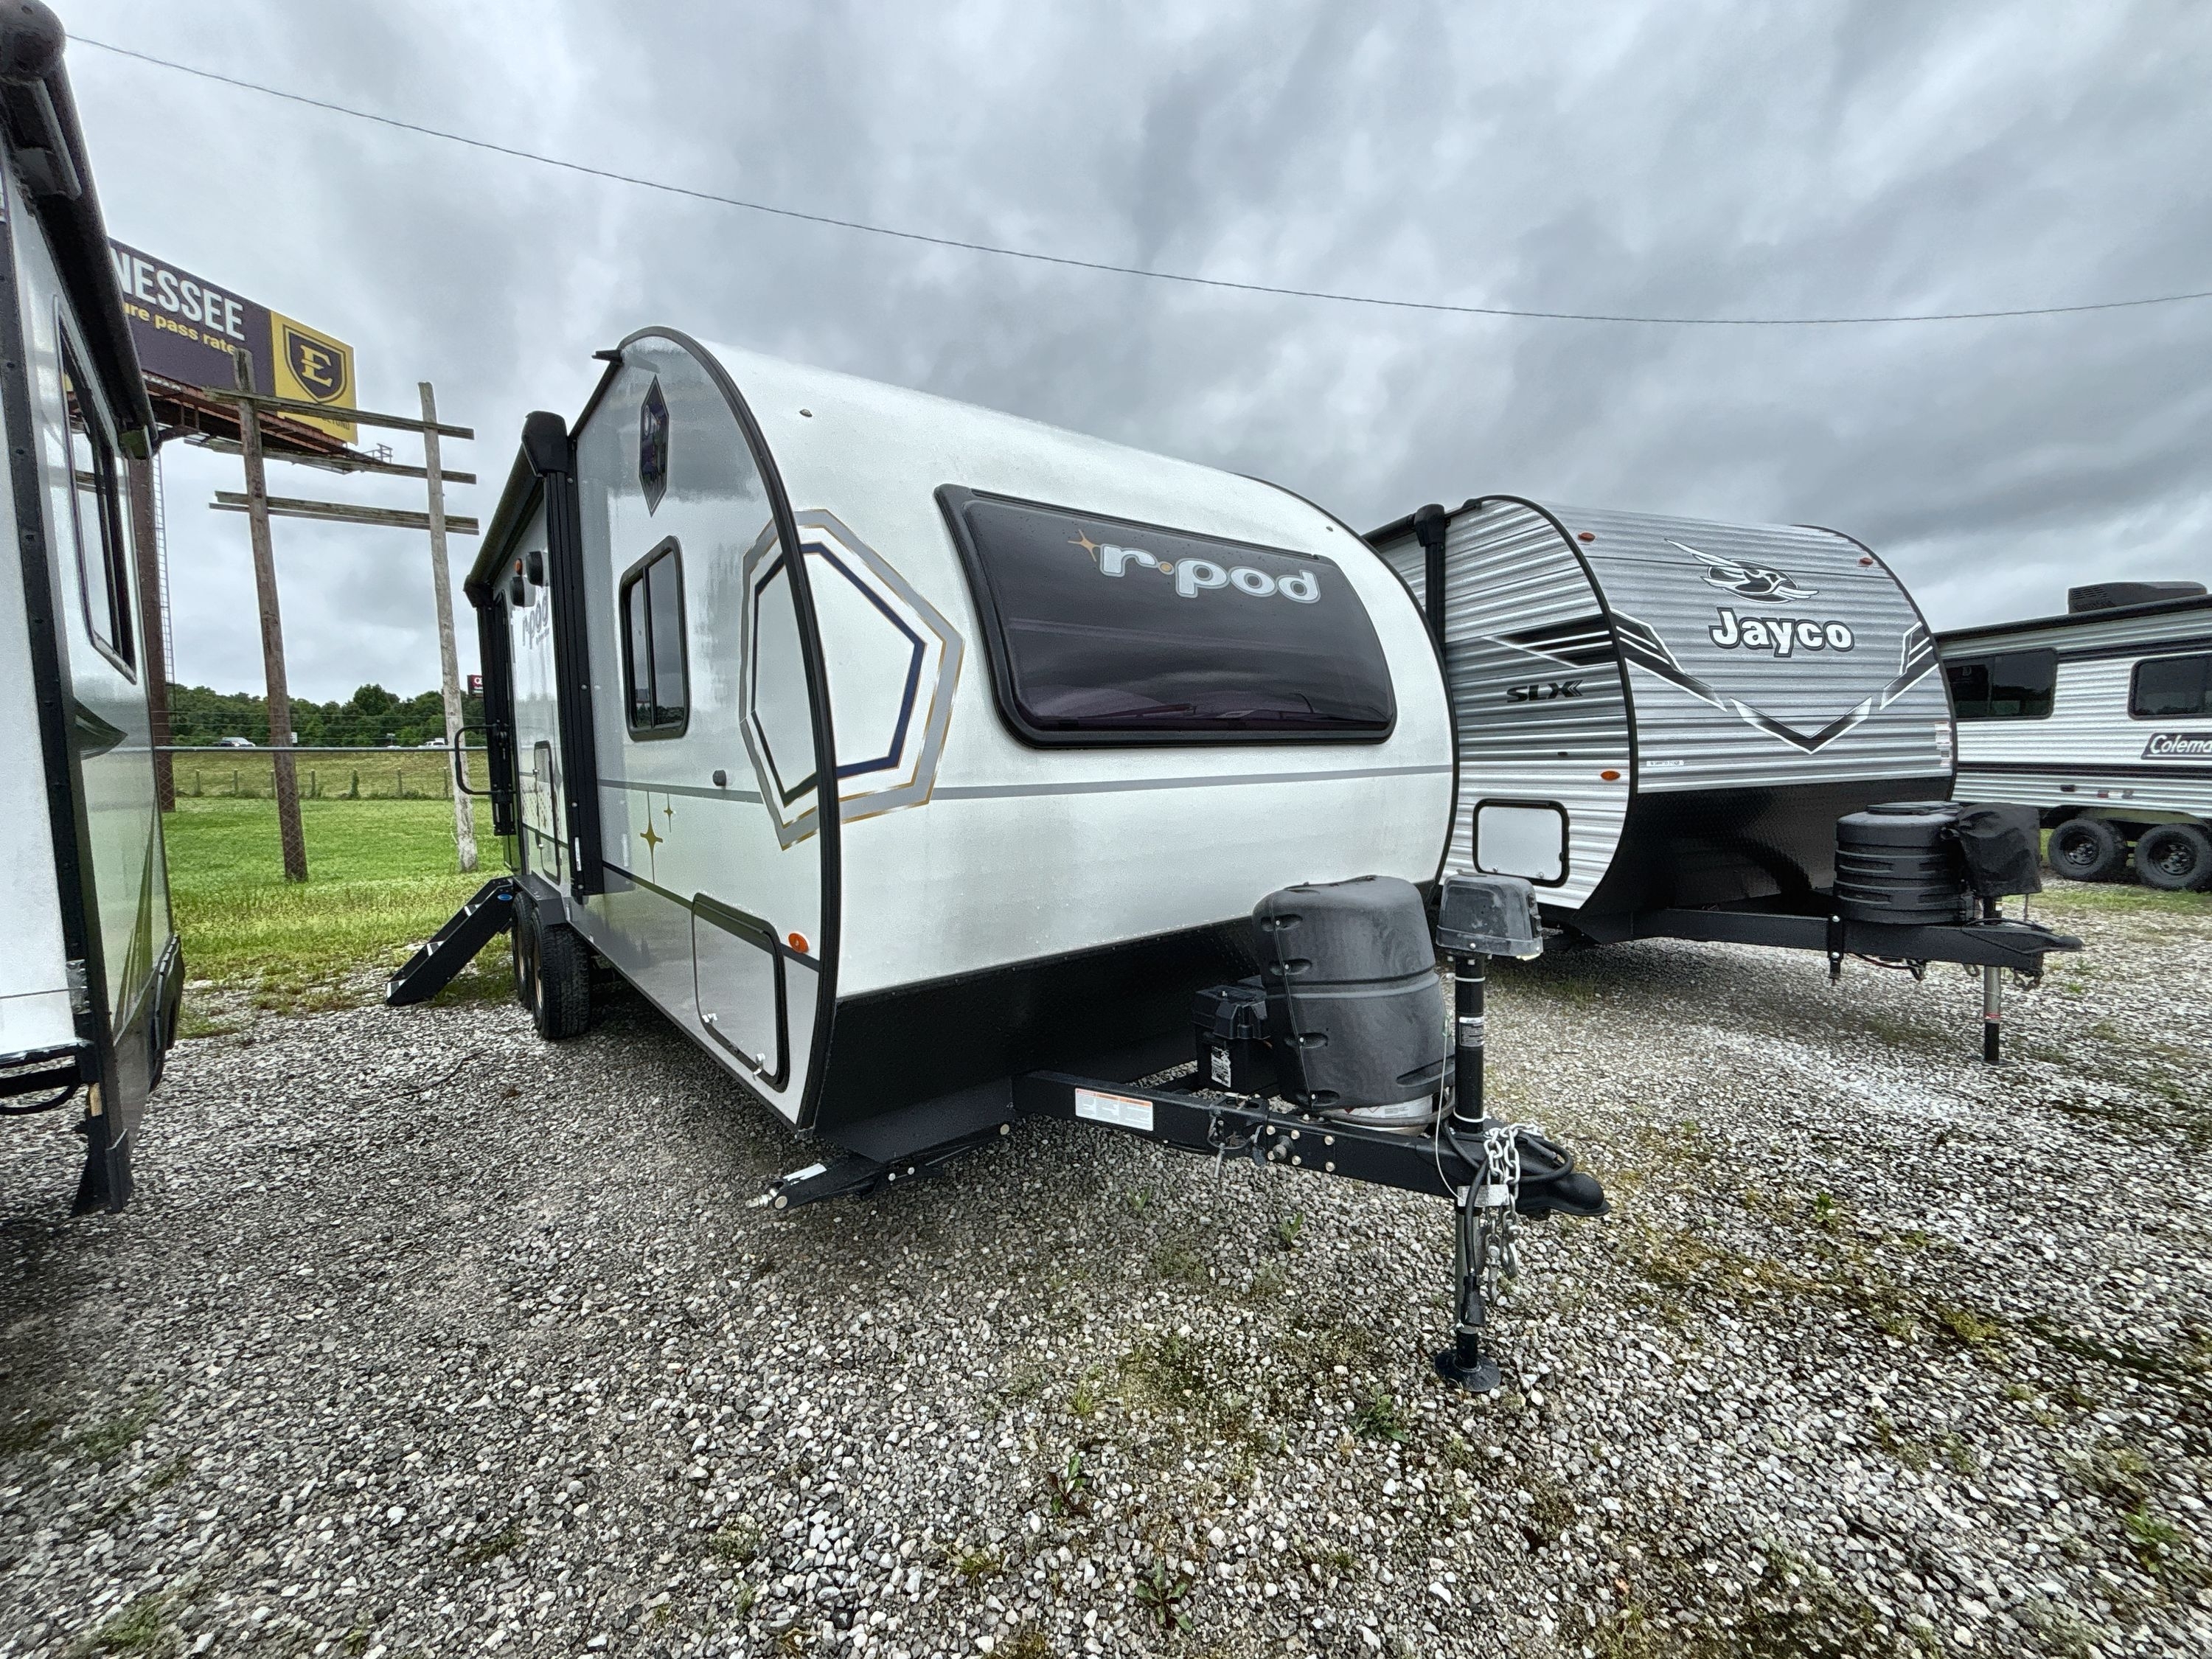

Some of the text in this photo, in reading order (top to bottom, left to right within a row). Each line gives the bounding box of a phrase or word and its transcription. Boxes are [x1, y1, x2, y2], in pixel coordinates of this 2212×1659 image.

[111, 247, 245, 341] NESSEE
[155, 314, 199, 341] pass
[1708, 607, 1855, 658] Jayco
[1506, 680, 1583, 703] SLX
